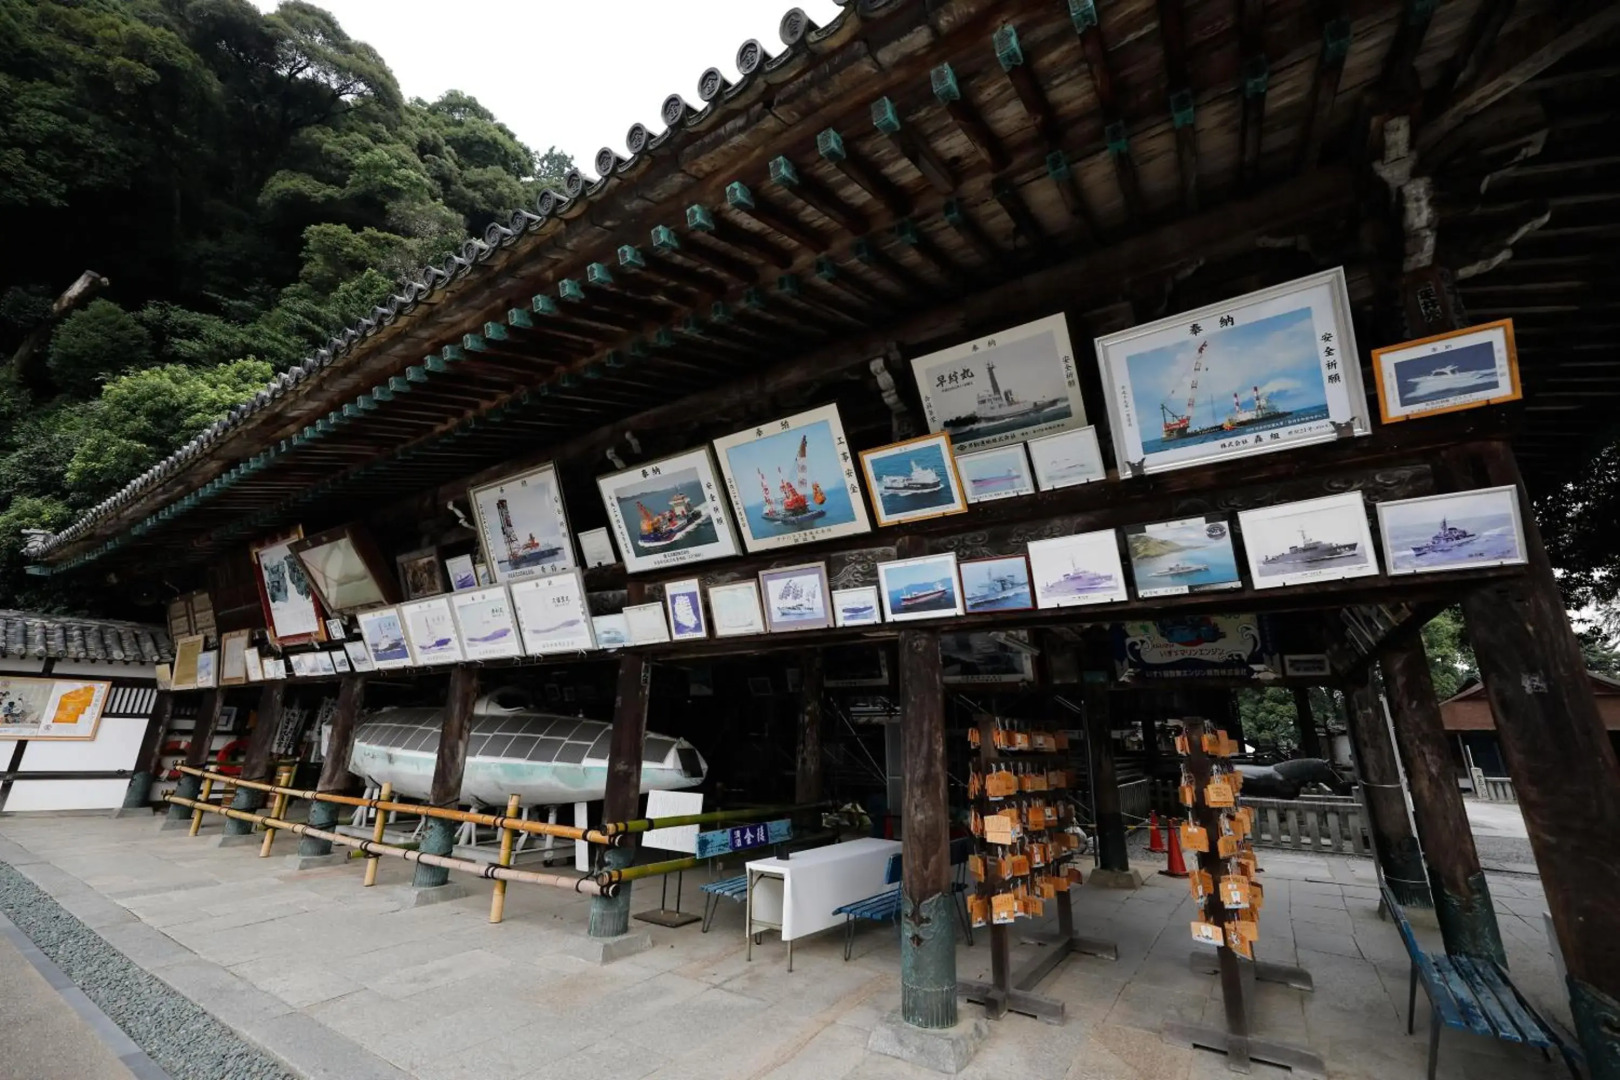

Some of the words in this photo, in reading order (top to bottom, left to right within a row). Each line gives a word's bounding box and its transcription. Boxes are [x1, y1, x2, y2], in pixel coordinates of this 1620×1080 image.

[1189, 315, 1235, 336] 奉納
[1320, 332, 1342, 384] 安全祈願
[756, 419, 790, 438] 奉納
[1219, 437, 1249, 450] 株式会社
[641, 467, 662, 479] 奉納
[836, 436, 859, 494] 工事安全
